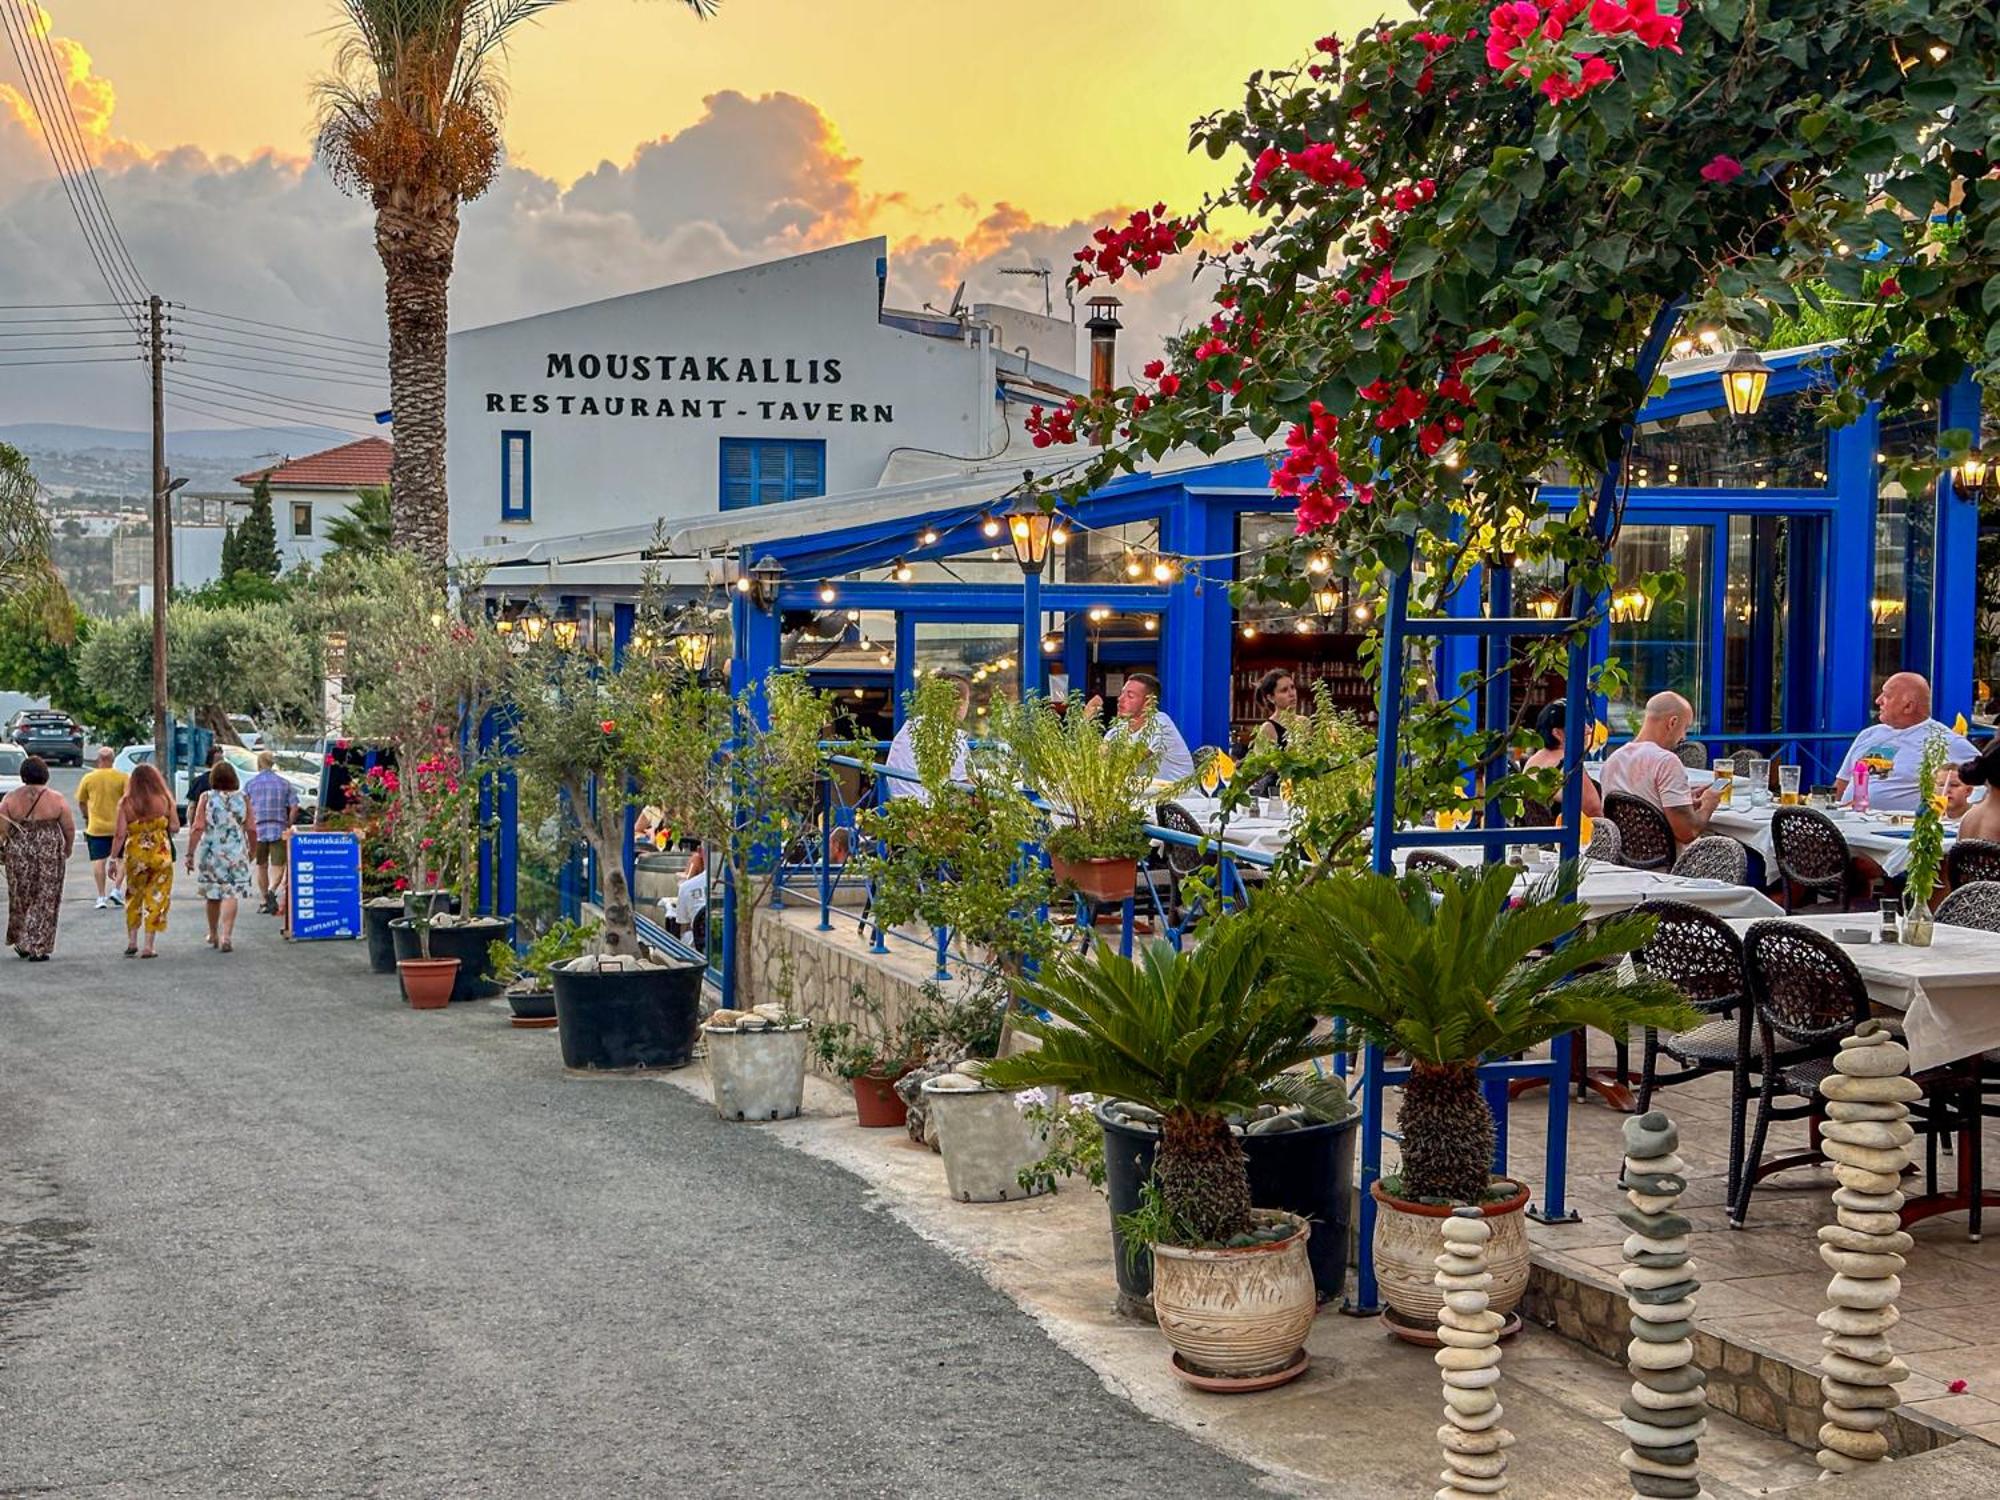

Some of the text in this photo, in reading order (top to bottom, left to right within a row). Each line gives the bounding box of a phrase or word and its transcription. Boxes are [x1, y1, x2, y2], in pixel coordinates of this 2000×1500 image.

[546, 353, 842, 385] MOUSTAKALLIS
[485, 392, 727, 419] RESTAURANT
[757, 401, 894, 423] TAVERN
